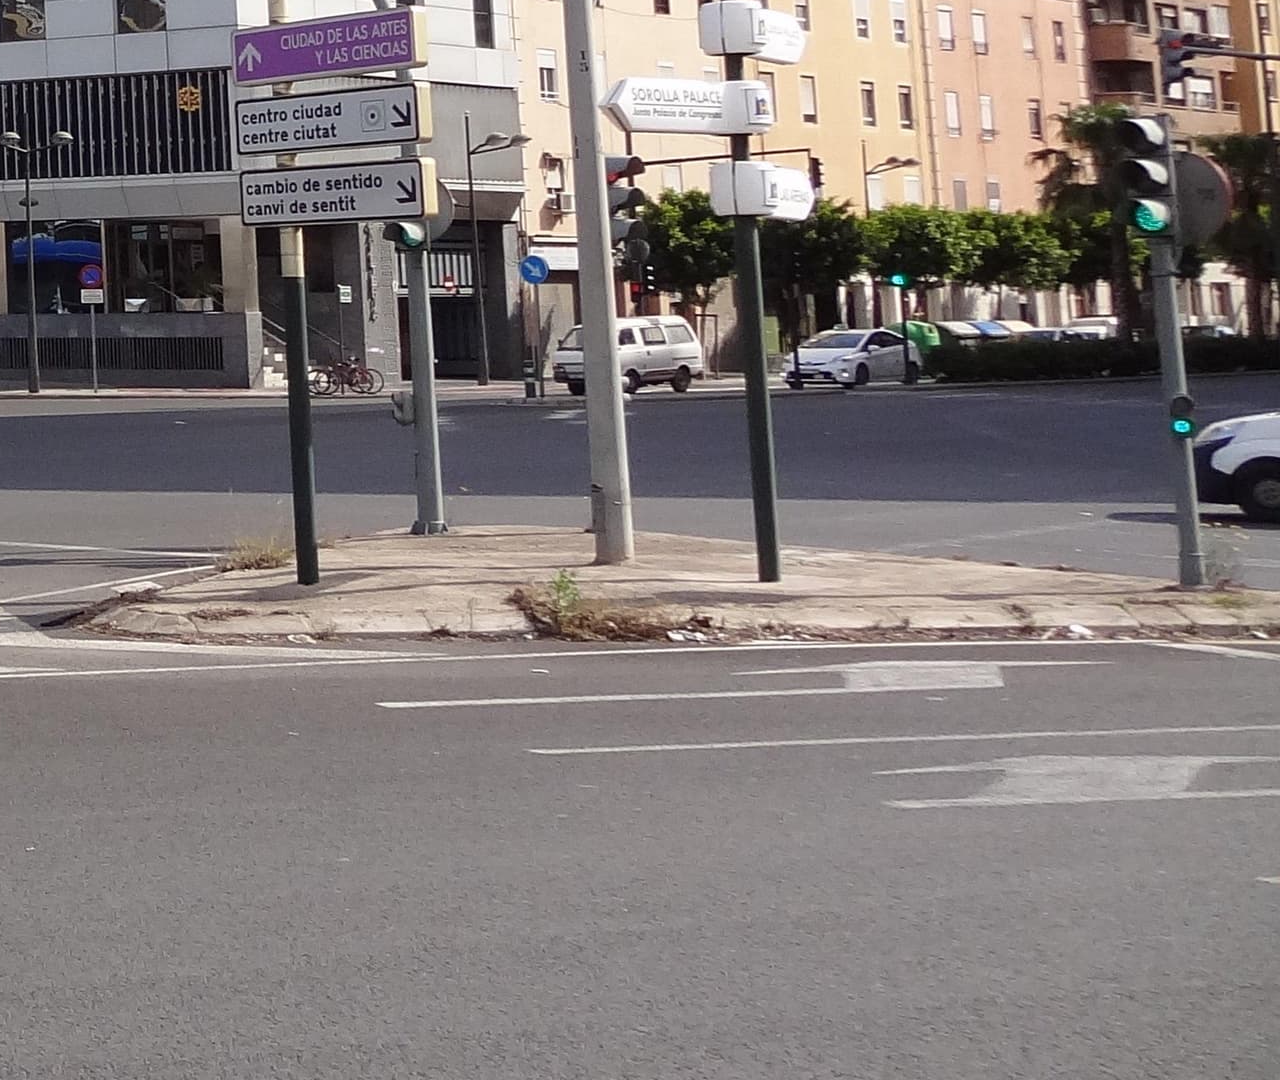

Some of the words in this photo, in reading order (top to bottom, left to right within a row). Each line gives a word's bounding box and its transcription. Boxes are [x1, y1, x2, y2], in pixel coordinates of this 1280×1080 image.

[280, 31, 324, 50] CIUDAD
[327, 28, 343, 45] DE
[346, 24, 369, 41] LAS
[371, 19, 408, 38] ARTES
[315, 51, 324, 66] Y
[327, 46, 348, 64] LAS
[352, 40, 408, 61] CIENCIAS
[632, 87, 681, 103] SOROLLA
[683, 89, 722, 104] PALACE
[241, 108, 288, 125] centro
[292, 102, 342, 120] ciudad
[243, 128, 289, 145] centre
[293, 123, 337, 141] ciutat
[246, 178, 298, 195] cambio
[302, 178, 321, 192] de
[325, 173, 383, 191] sentido
[247, 199, 284, 216] canvi
[289, 199, 308, 213] de
[312, 195, 356, 213] sentit
